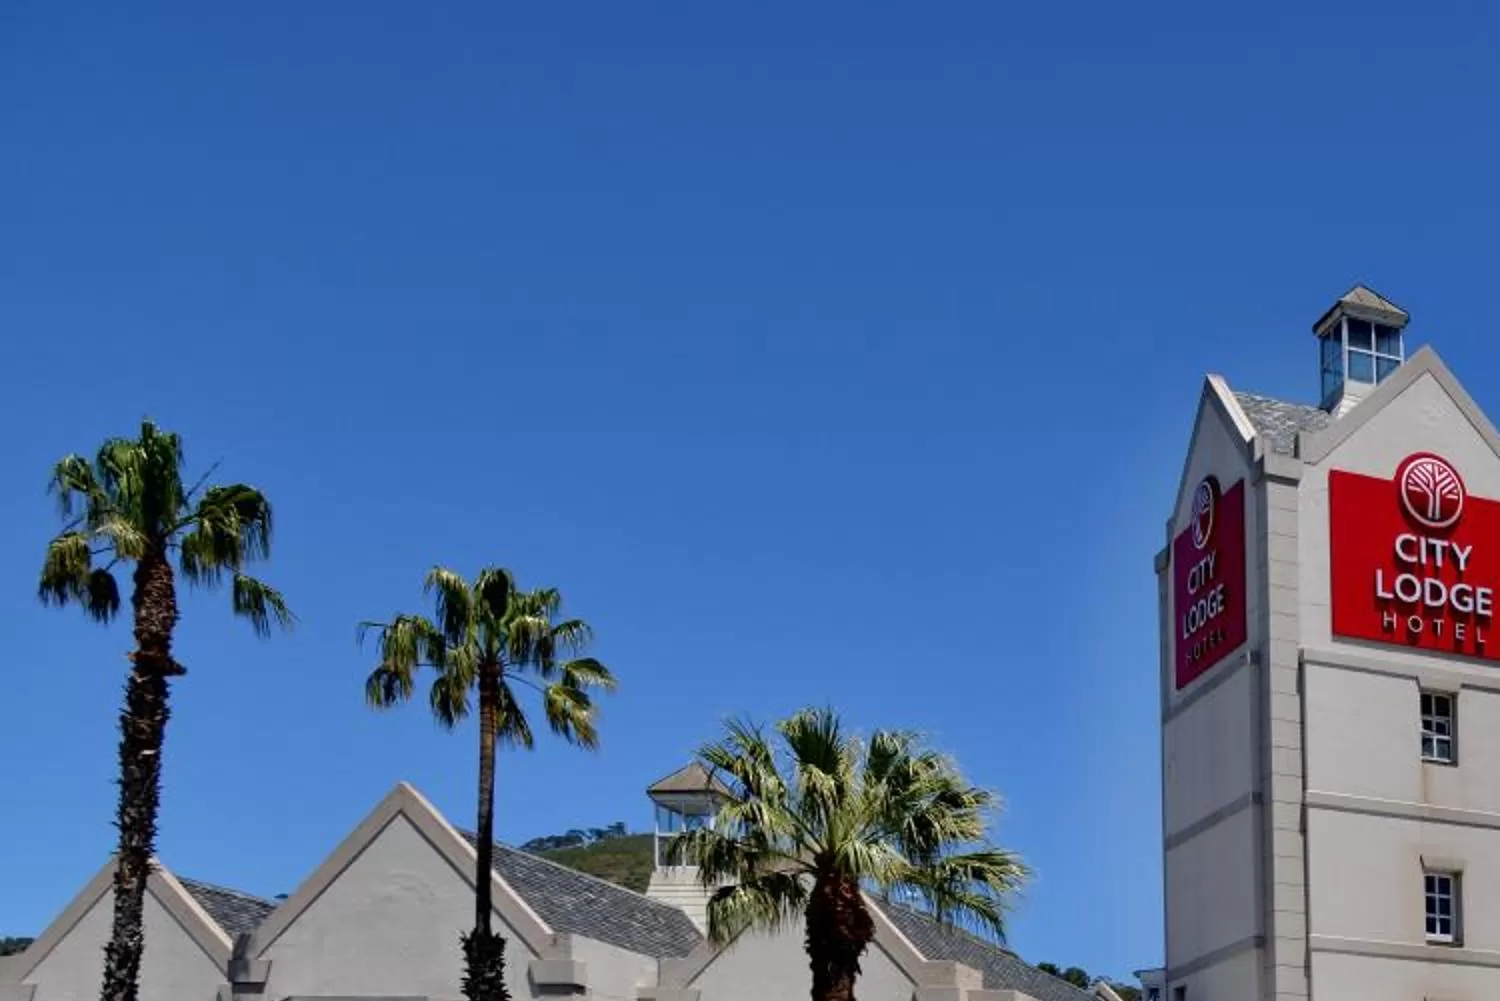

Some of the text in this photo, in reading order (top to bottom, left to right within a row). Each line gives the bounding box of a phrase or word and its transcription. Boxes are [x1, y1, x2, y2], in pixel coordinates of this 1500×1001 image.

[1187, 549, 1217, 595] CITY
[1395, 533, 1472, 571] CITY
[1182, 583, 1225, 639] LODGE
[1375, 569, 1493, 616] LODGE
[1184, 629, 1224, 664] HOTEL
[1383, 611, 1486, 643] HOTEL
